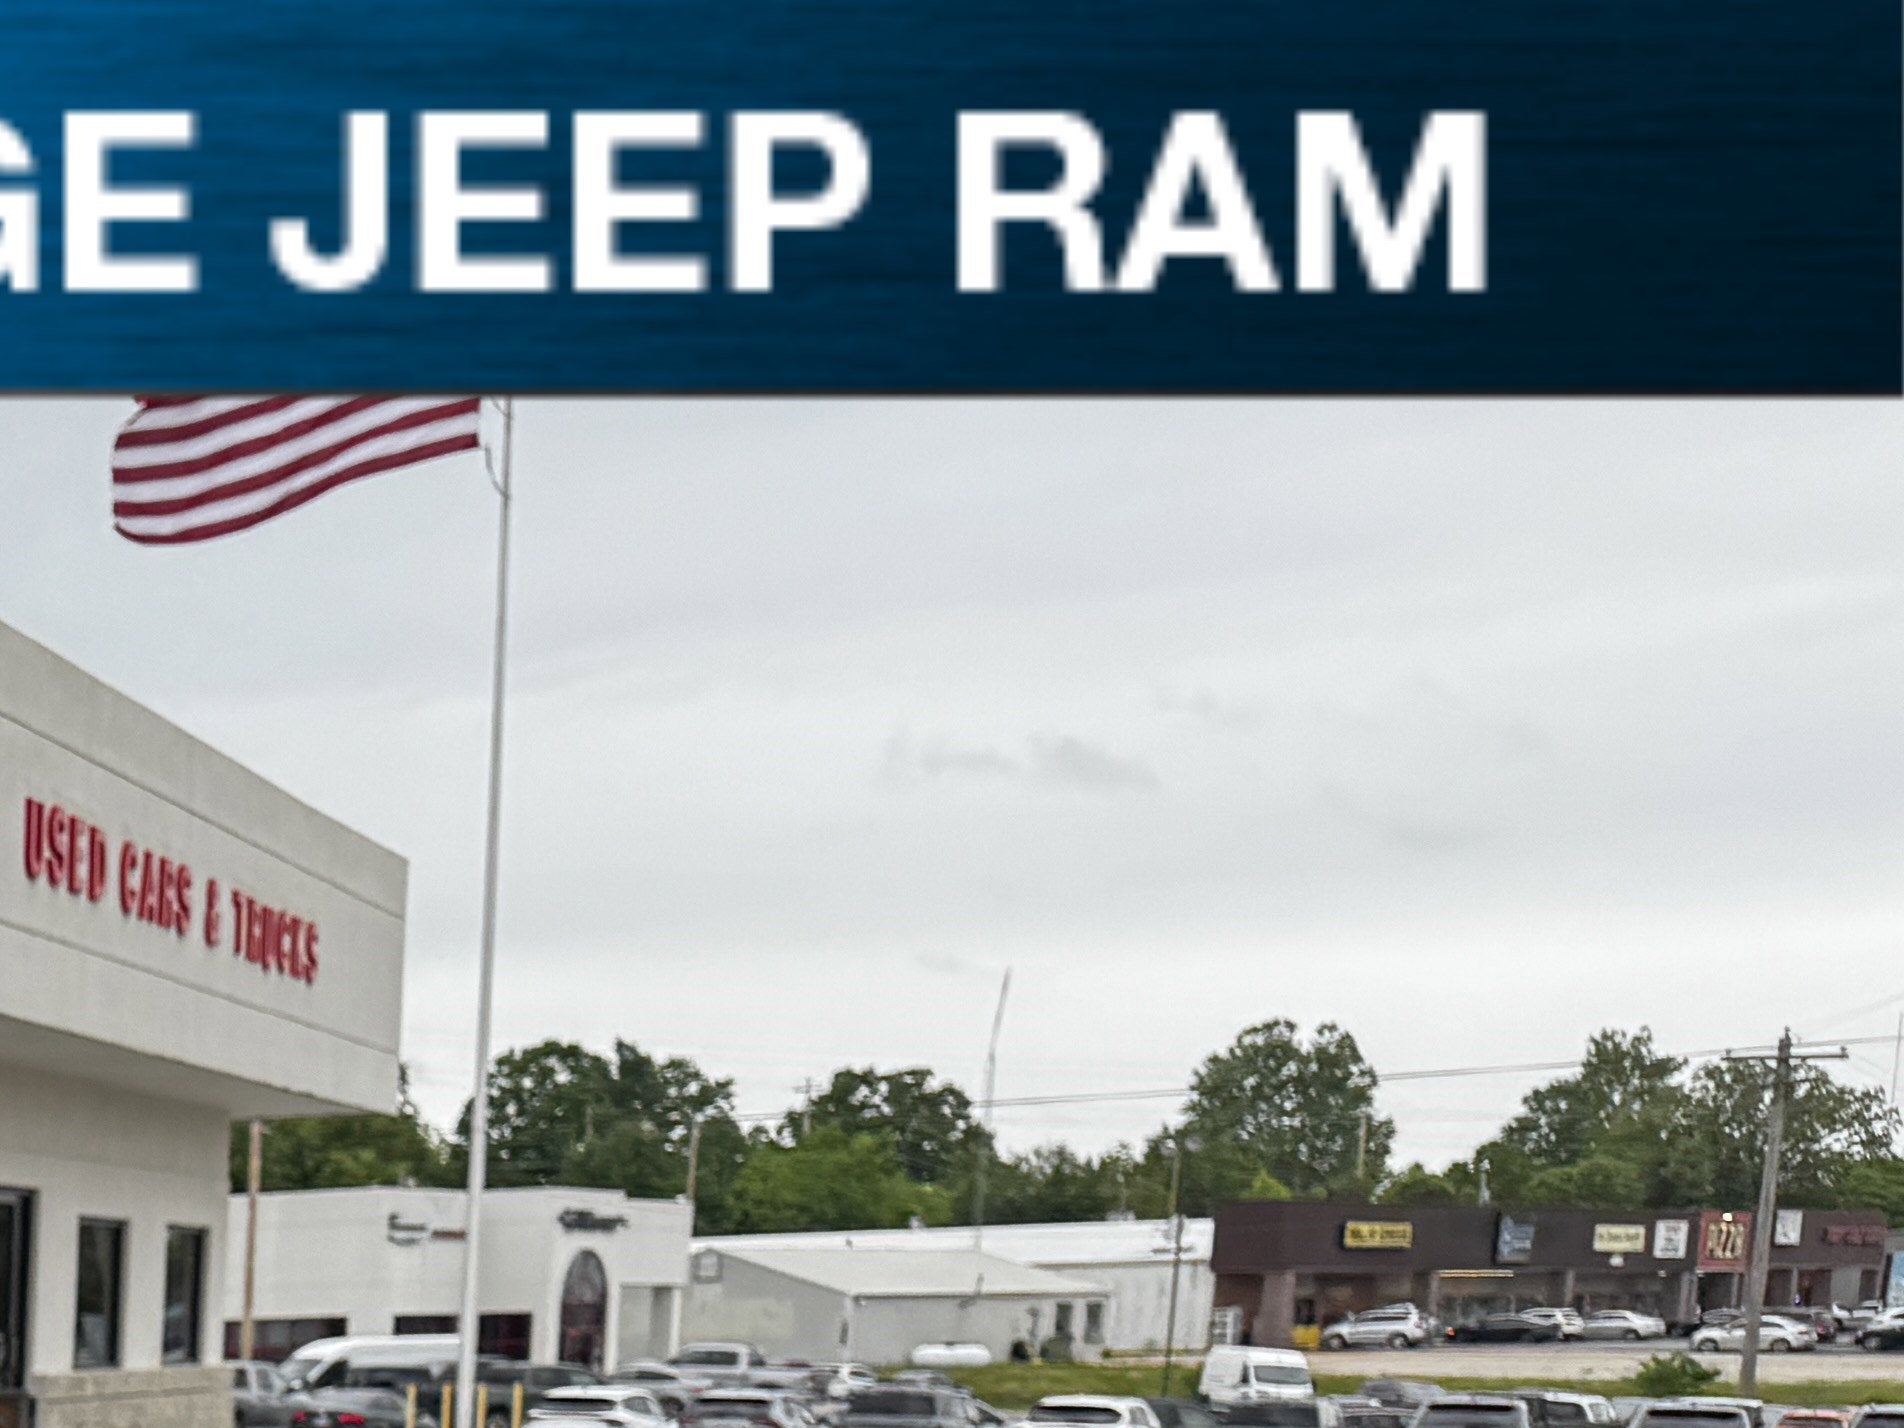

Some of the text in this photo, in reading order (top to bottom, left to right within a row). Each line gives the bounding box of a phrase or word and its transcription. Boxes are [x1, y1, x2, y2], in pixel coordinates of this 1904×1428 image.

[23, 796, 107, 904] USED
[119, 839, 192, 937] CARS
[204, 878, 220, 947] &
